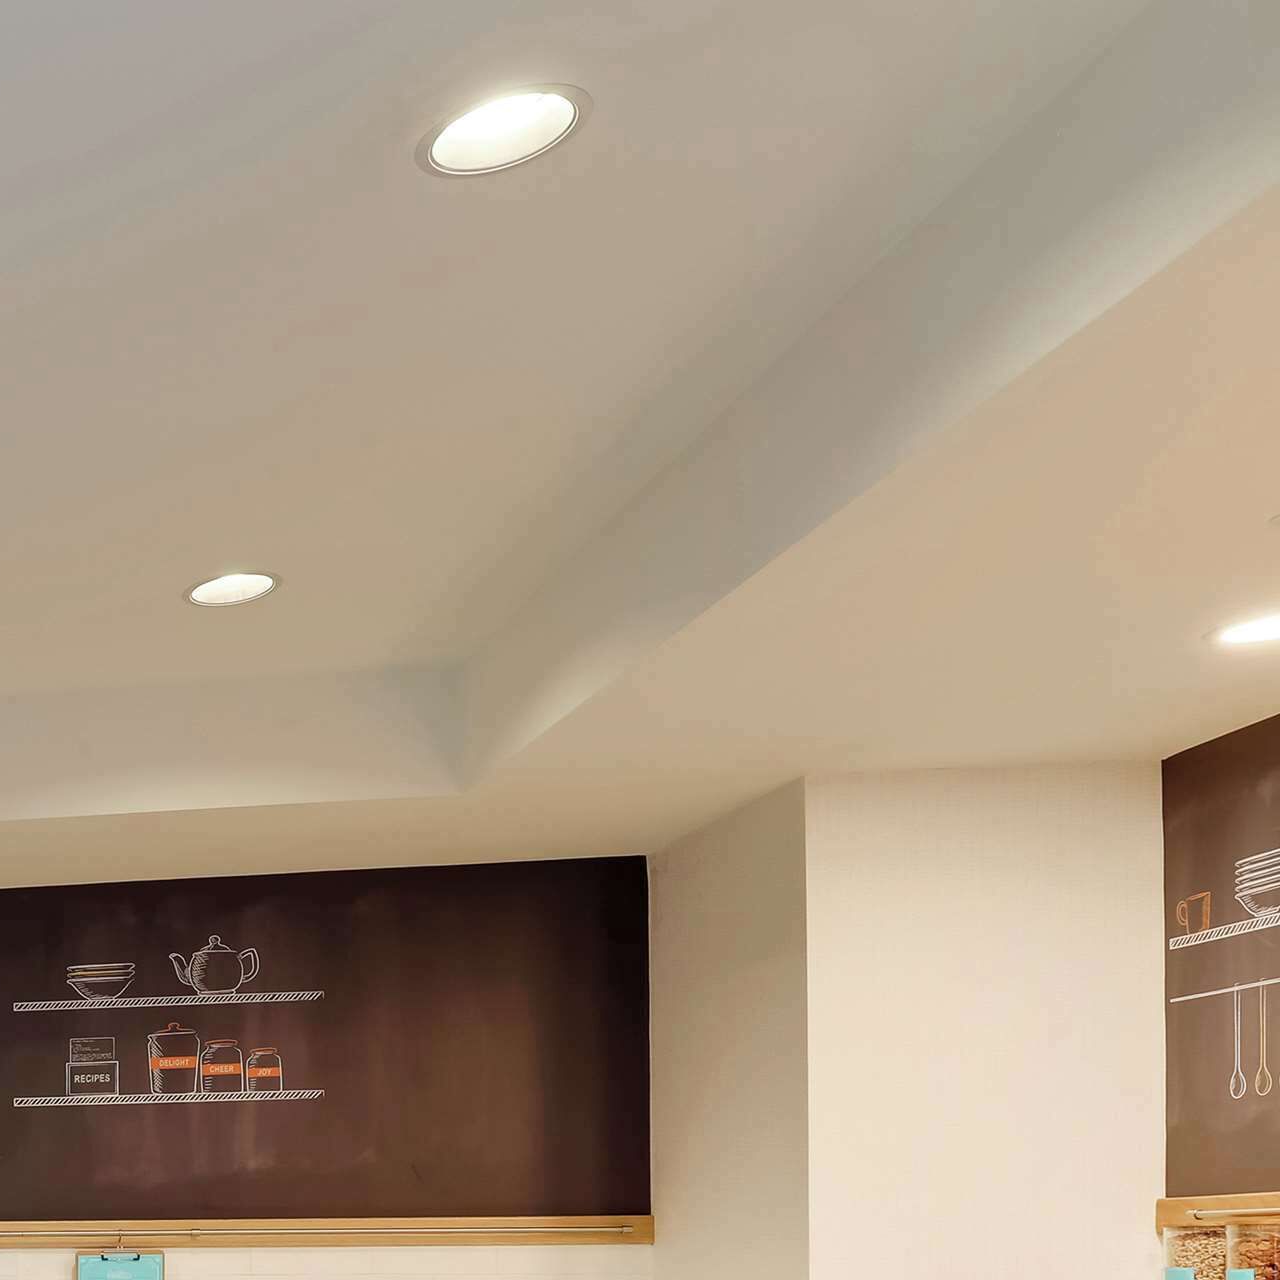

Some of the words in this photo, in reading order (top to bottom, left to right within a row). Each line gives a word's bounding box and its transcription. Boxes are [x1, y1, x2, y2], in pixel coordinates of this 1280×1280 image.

[159, 1058, 190, 1068] DELIGHT
[209, 1065, 235, 1074] CHEER
[256, 1068, 273, 1076] JOY
[73, 1073, 111, 1083] RECIPES
